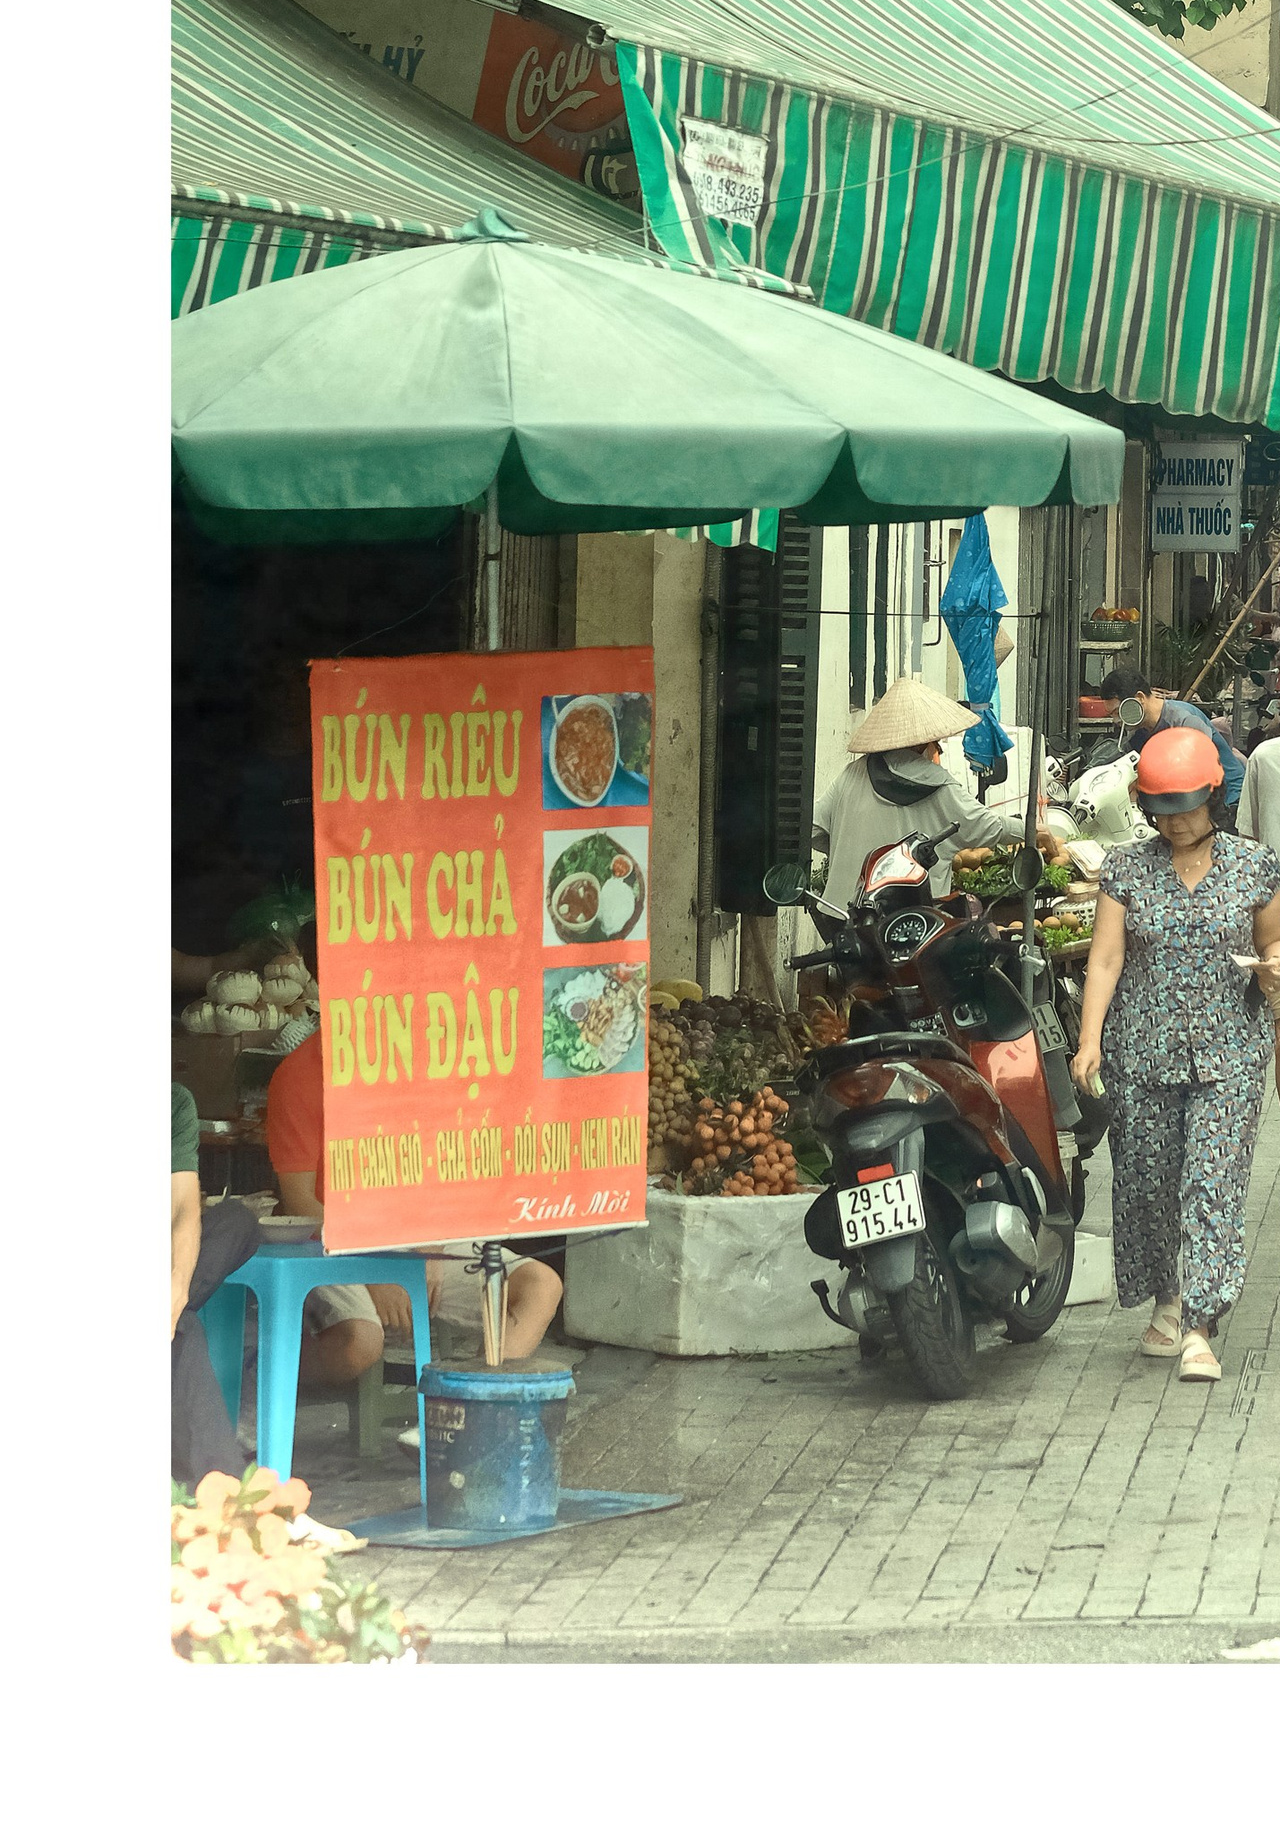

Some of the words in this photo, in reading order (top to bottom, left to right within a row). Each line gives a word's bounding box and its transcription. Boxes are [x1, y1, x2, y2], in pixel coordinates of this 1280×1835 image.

[1156, 458, 1234, 487] PHARMACY
[1156, 501, 1184, 535] NHÀ
[1188, 499, 1232, 536] THUỐC
[321, 687, 411, 804] BÚN
[421, 684, 523, 800] RIÊU
[326, 828, 414, 945] BÚN
[426, 814, 518, 940] CHẢ
[328, 969, 414, 1088] BÚN
[426, 961, 521, 1101] ĐẬU
[328, 1138, 356, 1203] THỊT
[436, 1106, 468, 1184] CHẢ
[470, 1107, 503, 1181] CỐM
[541, 1122, 572, 1186] SỤN
[581, 1117, 609, 1171] NEM
[611, 1105, 642, 1167] RÁN
[508, 1194, 577, 1223] Kính
[581, 1189, 632, 1218] Mời
[848, 1178, 905, 1215] 29-C1
[846, 1204, 918, 1243] 915.44
